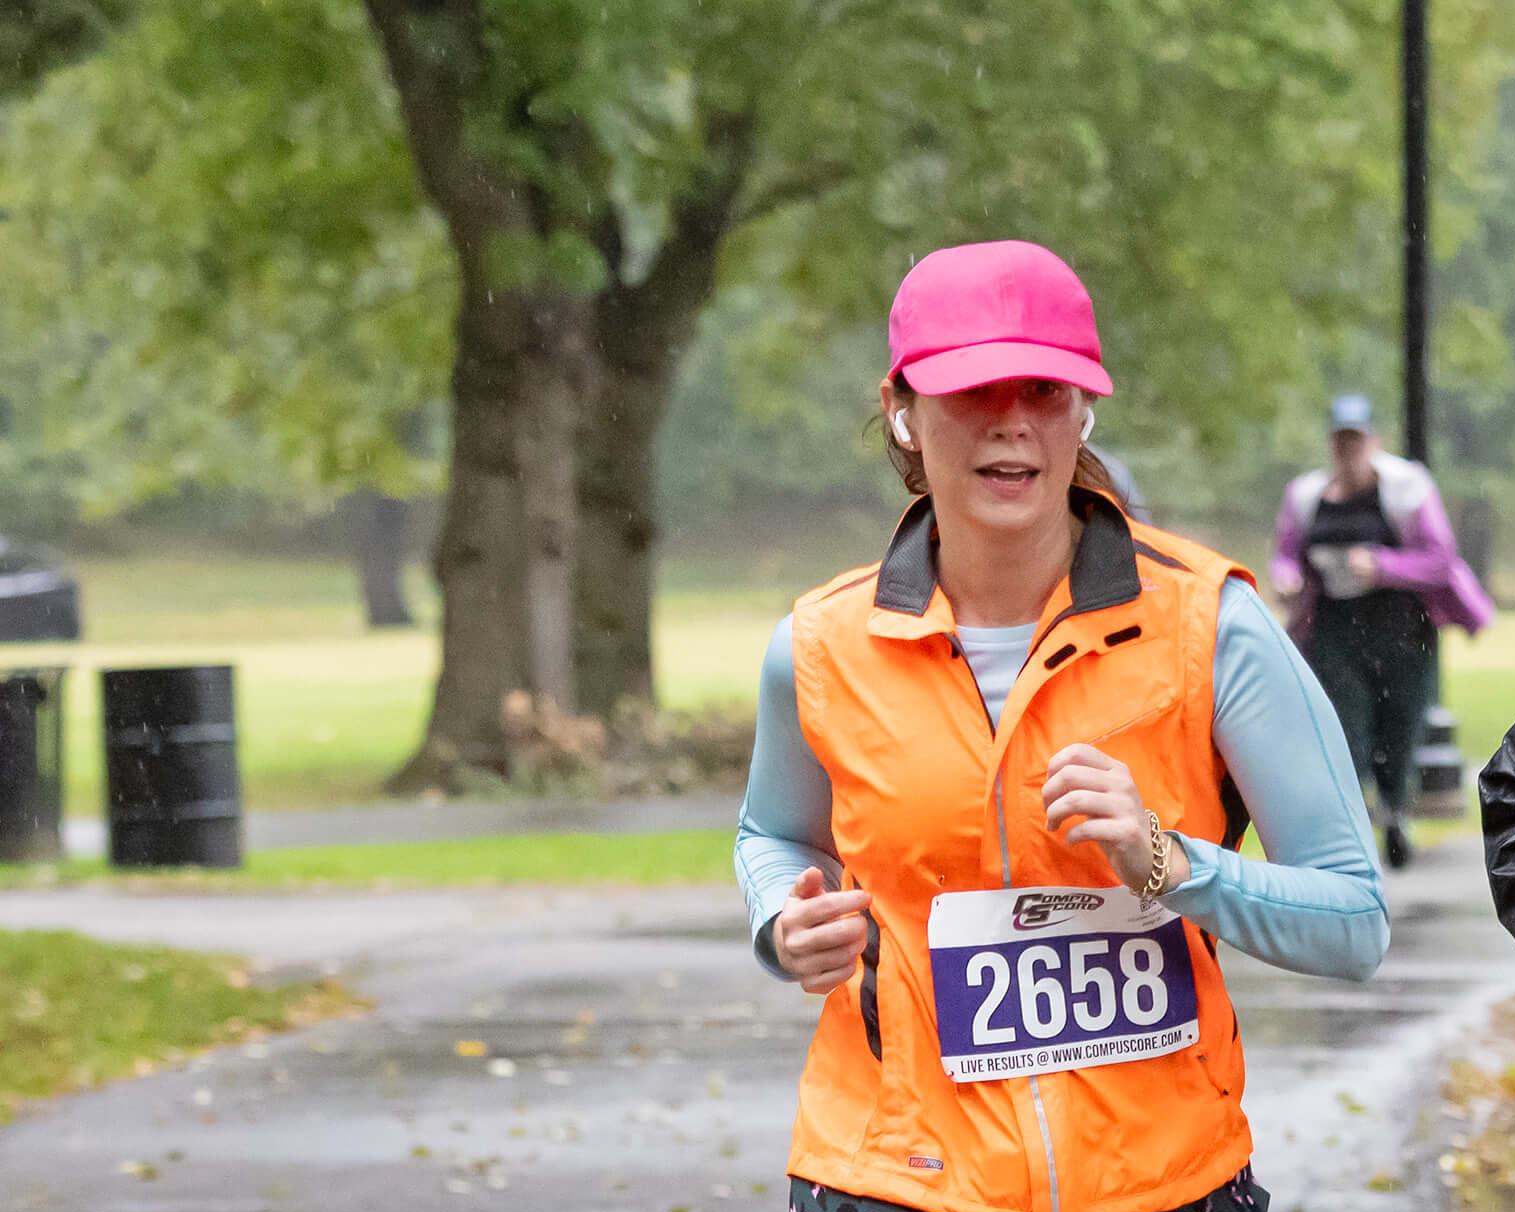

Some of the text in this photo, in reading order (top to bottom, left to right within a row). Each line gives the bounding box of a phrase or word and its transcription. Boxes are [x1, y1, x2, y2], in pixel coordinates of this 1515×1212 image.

[1012, 893, 1092, 915] COMPU
[1023, 903, 1099, 924] SCORE
[966, 938, 1168, 1046] 2658
[960, 1030, 1183, 1074] LIVE RESULTS @ WWW.COMPUSCORE.COM
